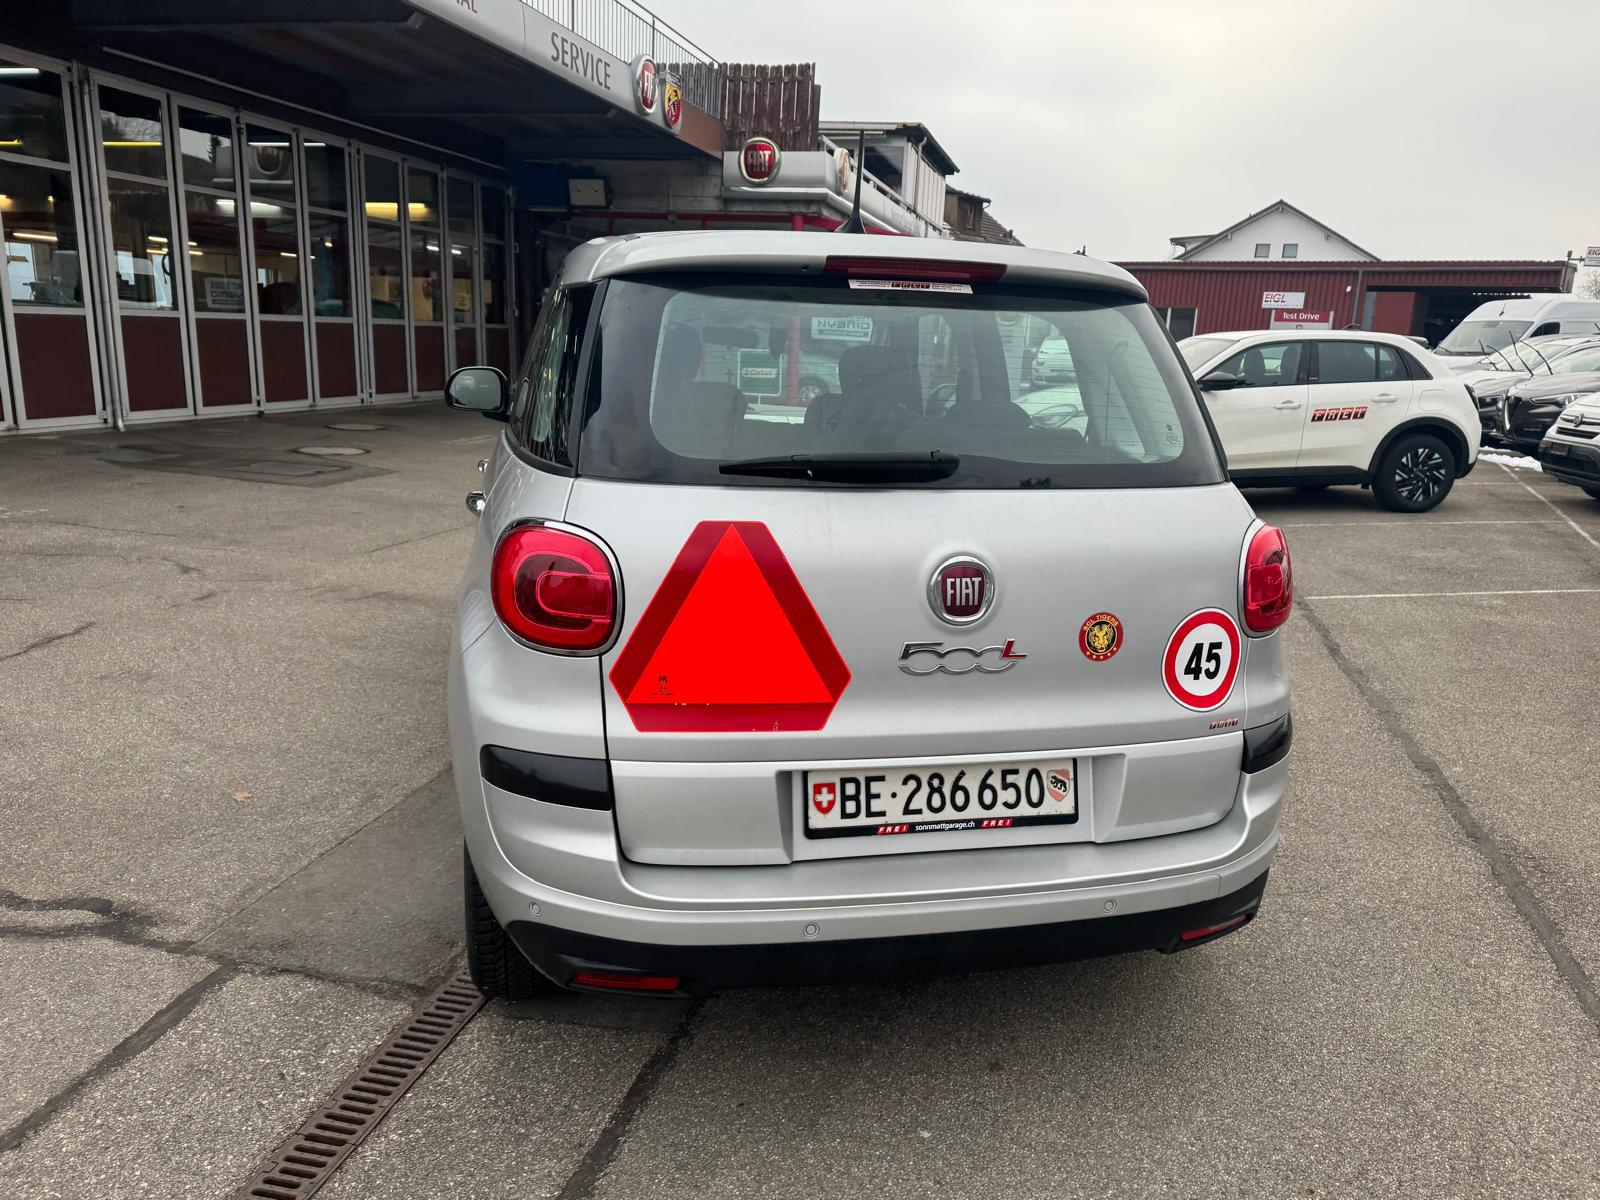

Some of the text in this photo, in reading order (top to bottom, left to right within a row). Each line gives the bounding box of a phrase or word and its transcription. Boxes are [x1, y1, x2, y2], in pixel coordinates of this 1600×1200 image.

[551, 31, 611, 90] SERVICE
[747, 150, 771, 172] FIAT
[1264, 293, 1286, 303] EIGL
[1283, 312, 1320, 320] Test Drive
[946, 577, 982, 607] FIAT
[1096, 614, 1119, 626] TIGERS
[1184, 641, 1223, 681] 45
[878, 819, 1013, 834] FREI sonnmattgarage.ch FREI
